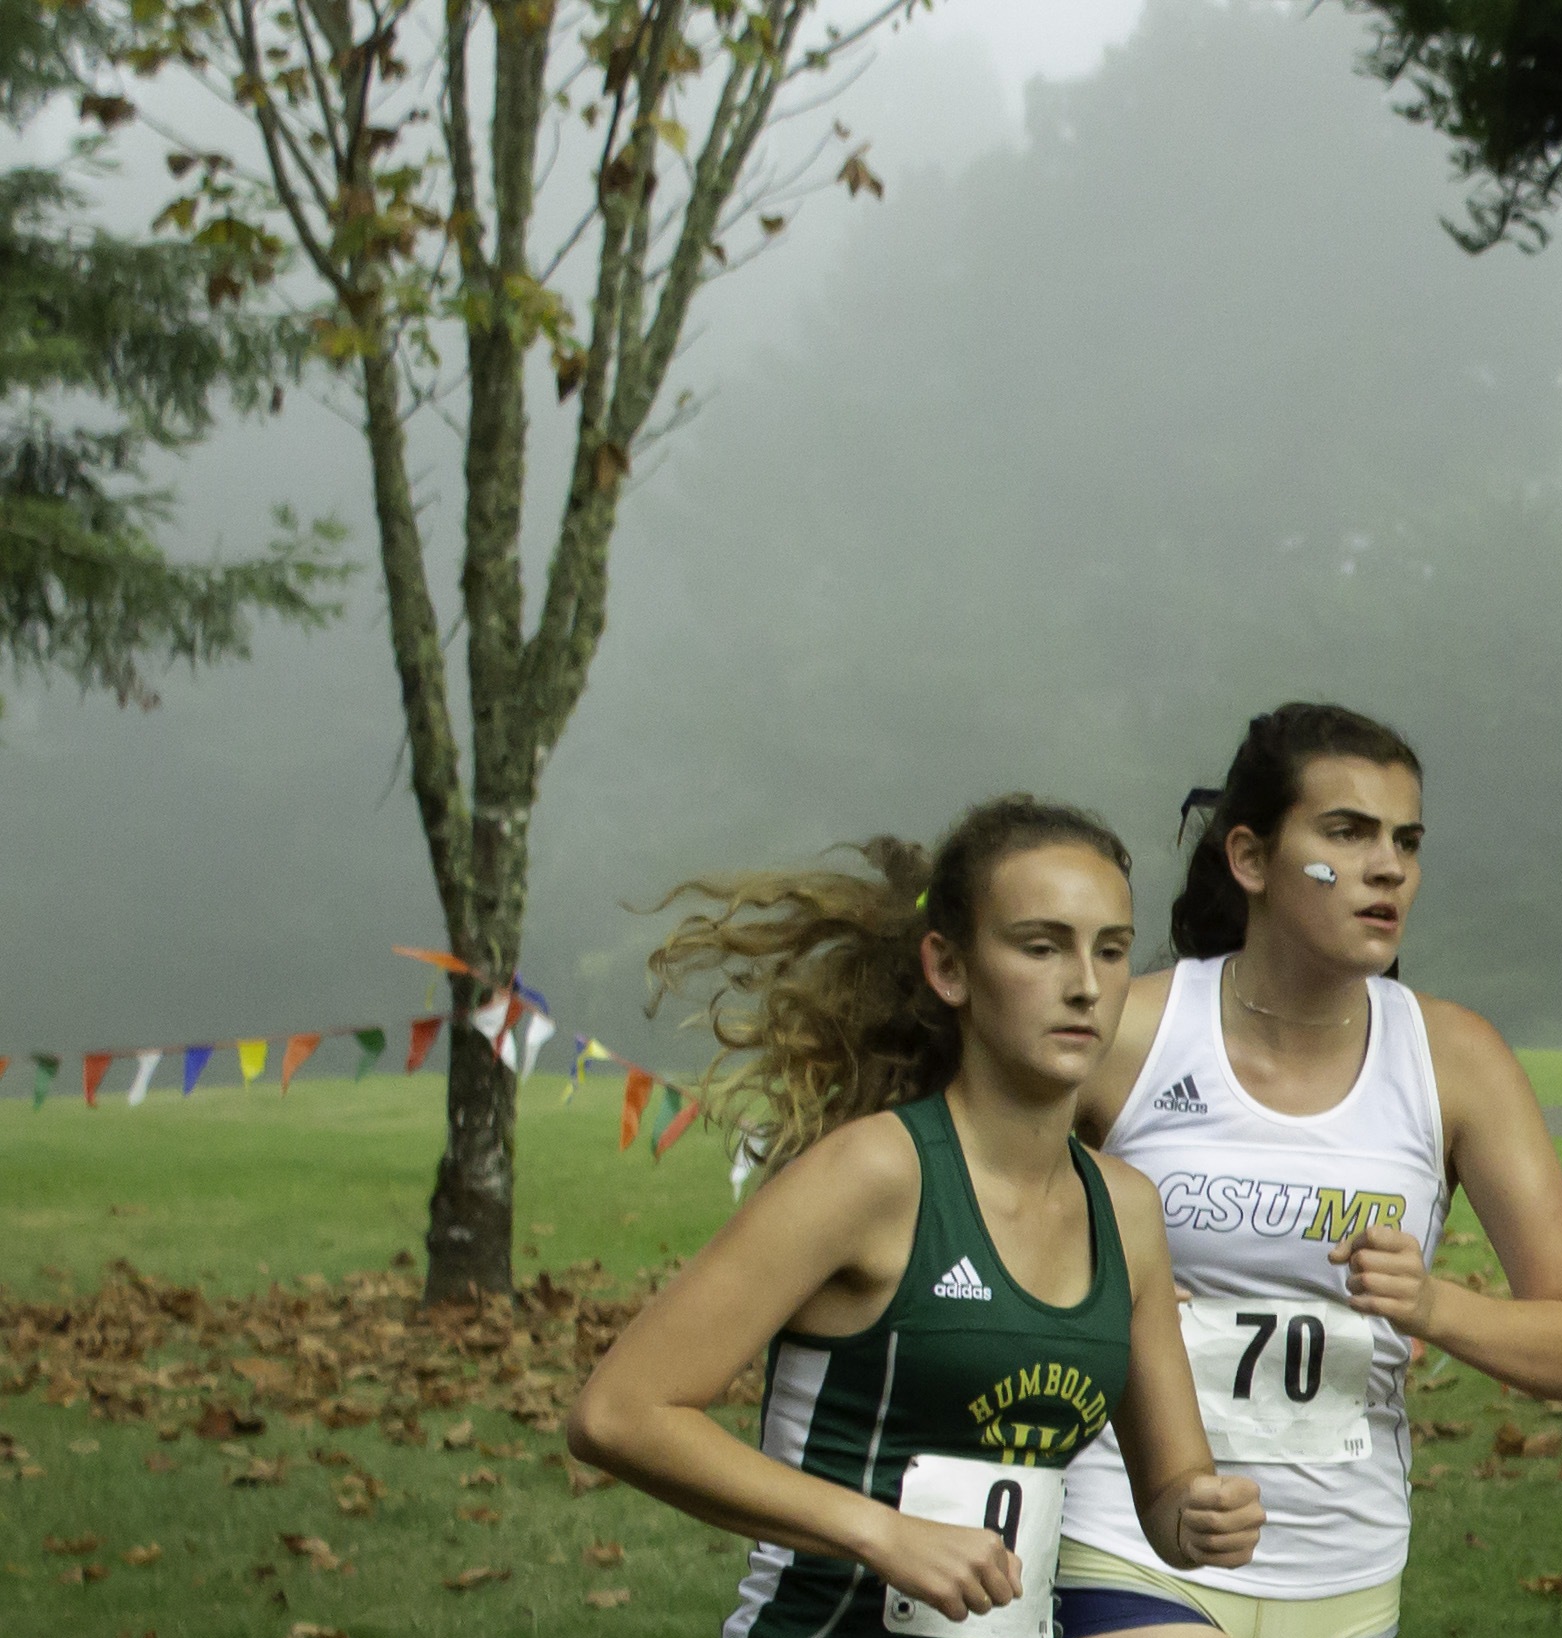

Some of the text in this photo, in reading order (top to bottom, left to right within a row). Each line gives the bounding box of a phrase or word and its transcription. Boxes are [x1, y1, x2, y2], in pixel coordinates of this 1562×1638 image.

[1154, 1097, 1208, 1115] adidas
[934, 1280, 992, 1301] adidas
[1232, 1312, 1325, 1403] 70
